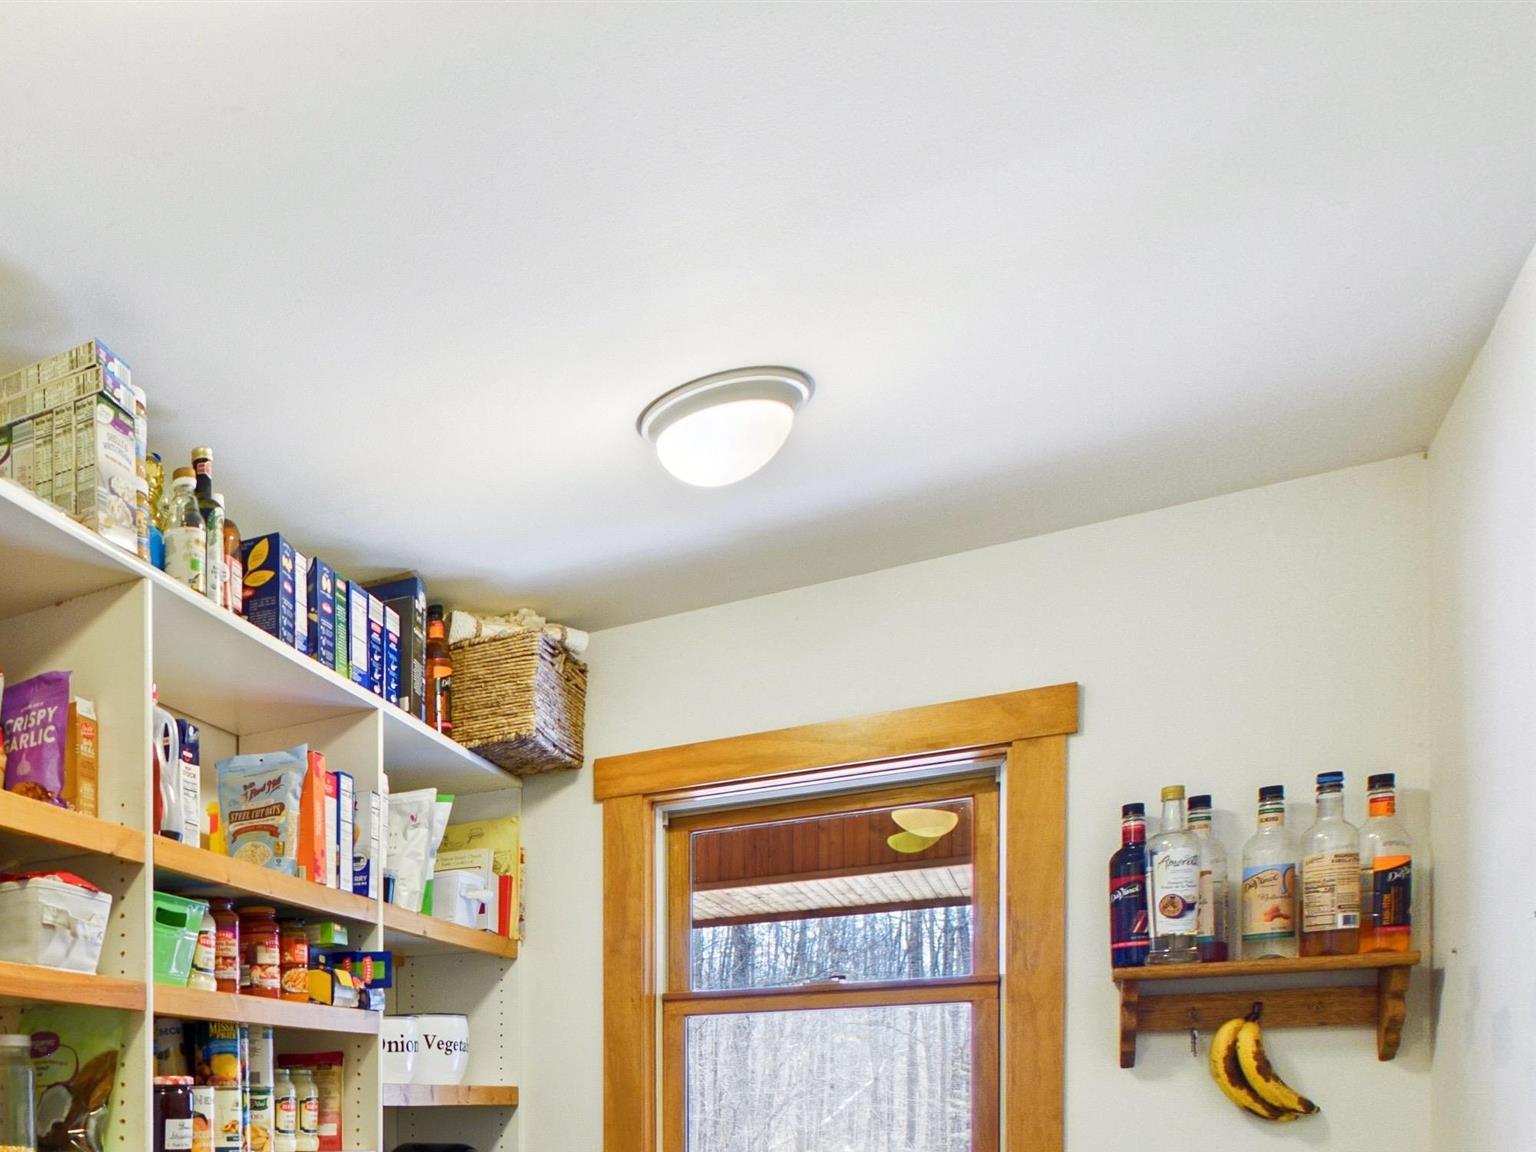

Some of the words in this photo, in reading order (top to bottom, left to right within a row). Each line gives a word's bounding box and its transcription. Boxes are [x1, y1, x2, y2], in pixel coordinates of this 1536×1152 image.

[5, 705, 59, 735] CRISPY
[230, 810, 251, 823] STEEL
[251, 808, 264, 819] CUT
[264, 804, 282, 817] OATS
[382, 1033, 420, 1053] nion
[423, 1034, 470, 1056] Vegeta
